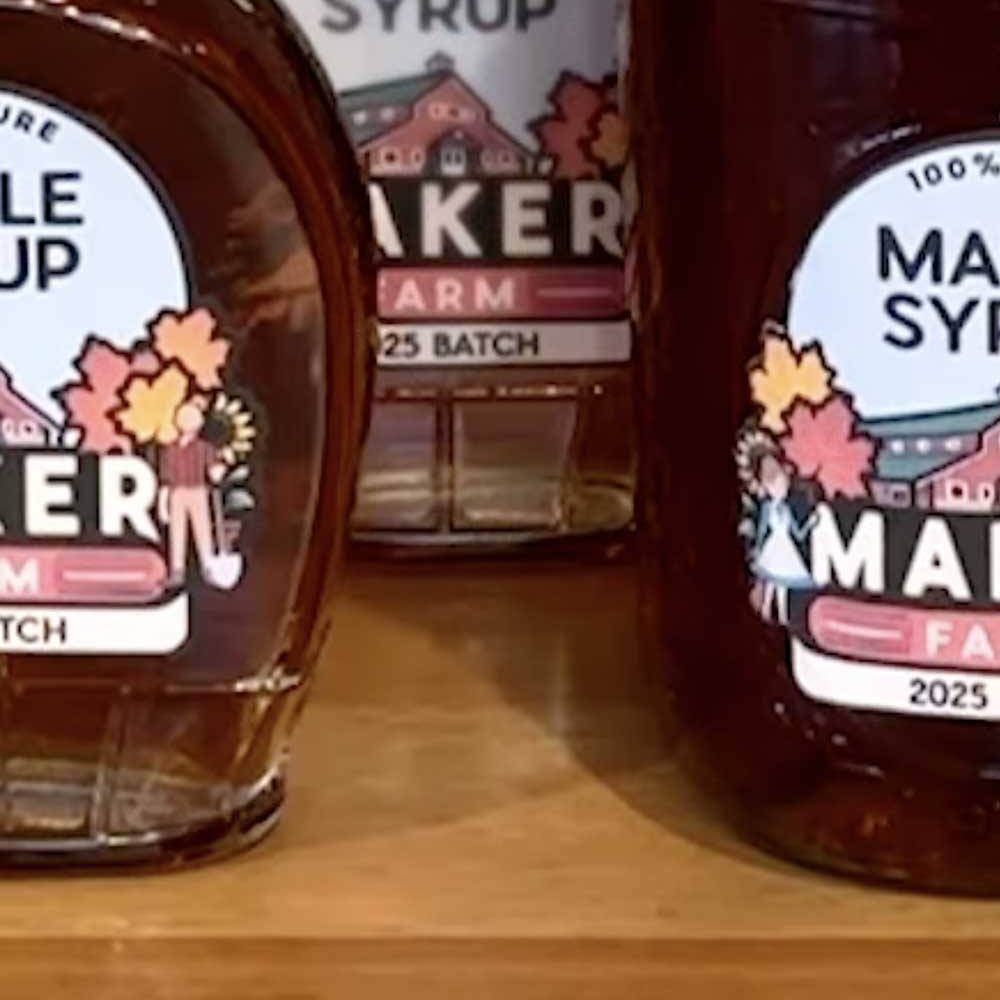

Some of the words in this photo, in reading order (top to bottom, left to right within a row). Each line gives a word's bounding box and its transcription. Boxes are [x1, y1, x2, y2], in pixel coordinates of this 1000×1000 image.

[380, 276, 515, 311] ARM
[433, 332, 539, 357] BATCH
[909, 679, 988, 709] 2025
